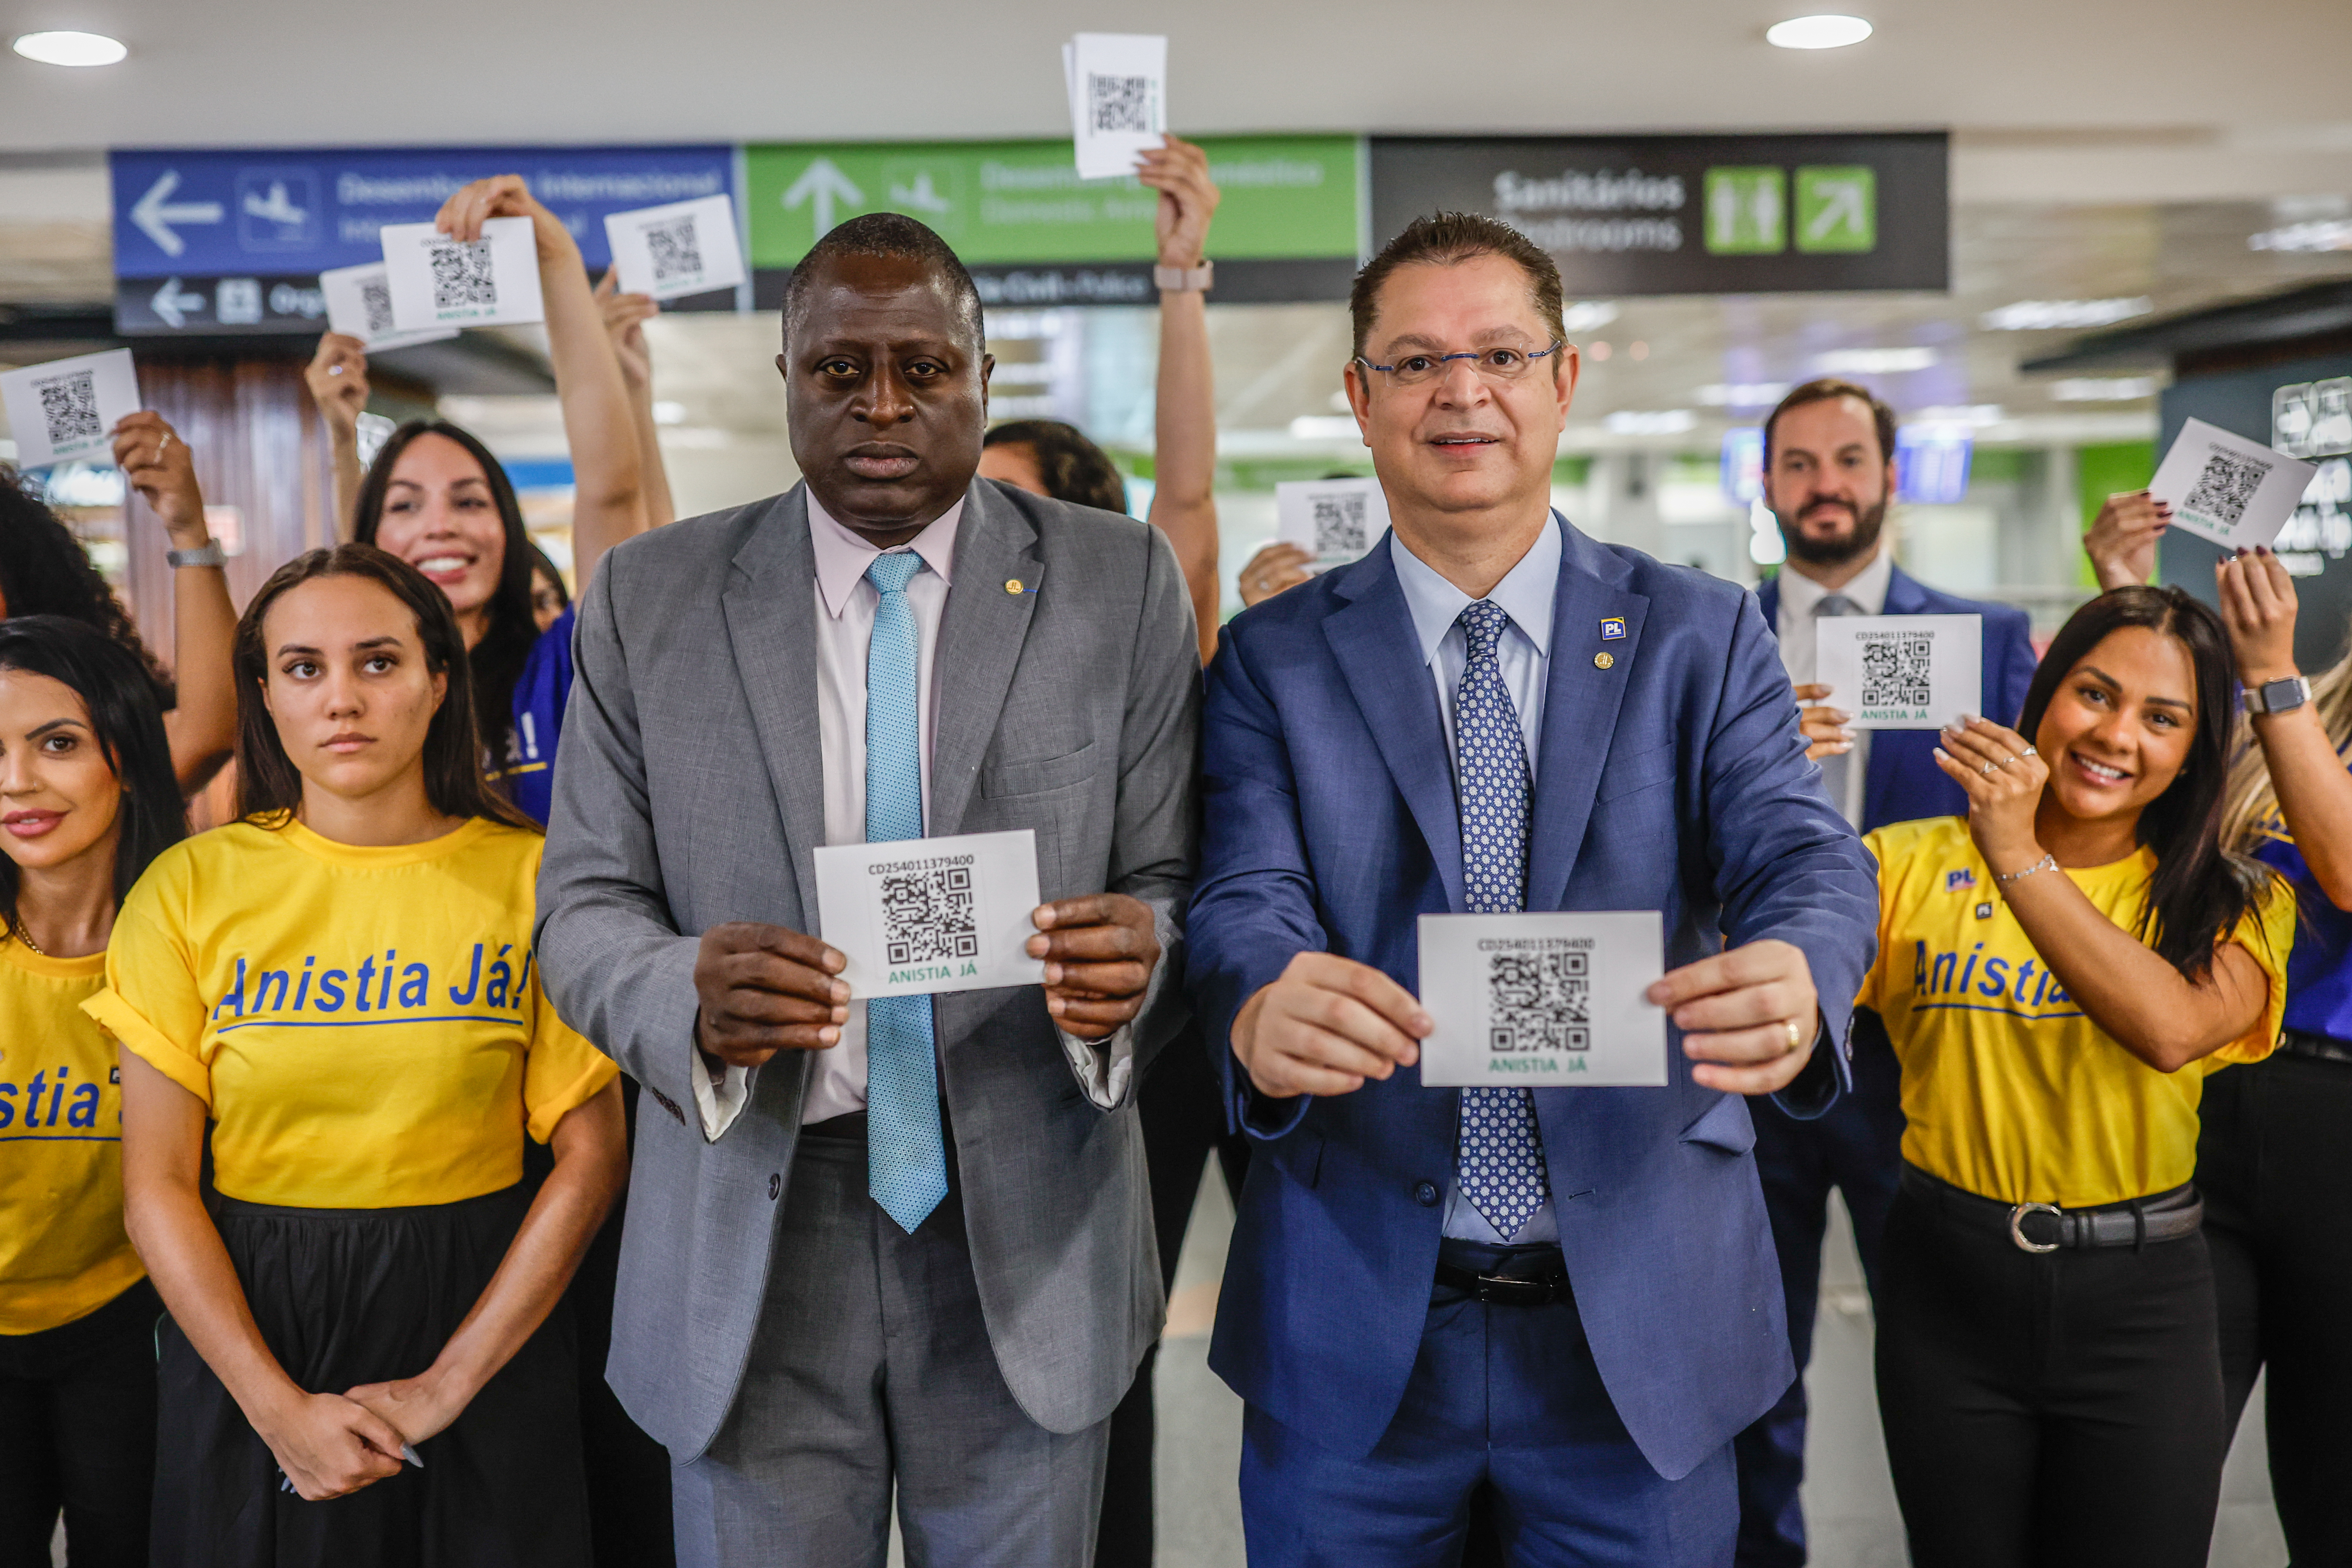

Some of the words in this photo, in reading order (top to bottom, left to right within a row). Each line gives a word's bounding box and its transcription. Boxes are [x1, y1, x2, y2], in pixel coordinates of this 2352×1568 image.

[1495, 169, 1683, 208] Sanitários
[1605, 622, 1622, 634] PL
[1861, 709, 1908, 720] ANISTIA
[1914, 708, 1927, 720] JÁ
[868, 854, 975, 875] CD254011379400
[1948, 869, 1975, 887] PL
[212, 949, 429, 1020] Anistia
[449, 943, 532, 1010] Já!
[888, 965, 951, 984] ANISTIA
[959, 960, 977, 977] JÁ
[1489, 1057, 1559, 1073] ANISTIA
[1568, 1055, 1587, 1073] JÁ
